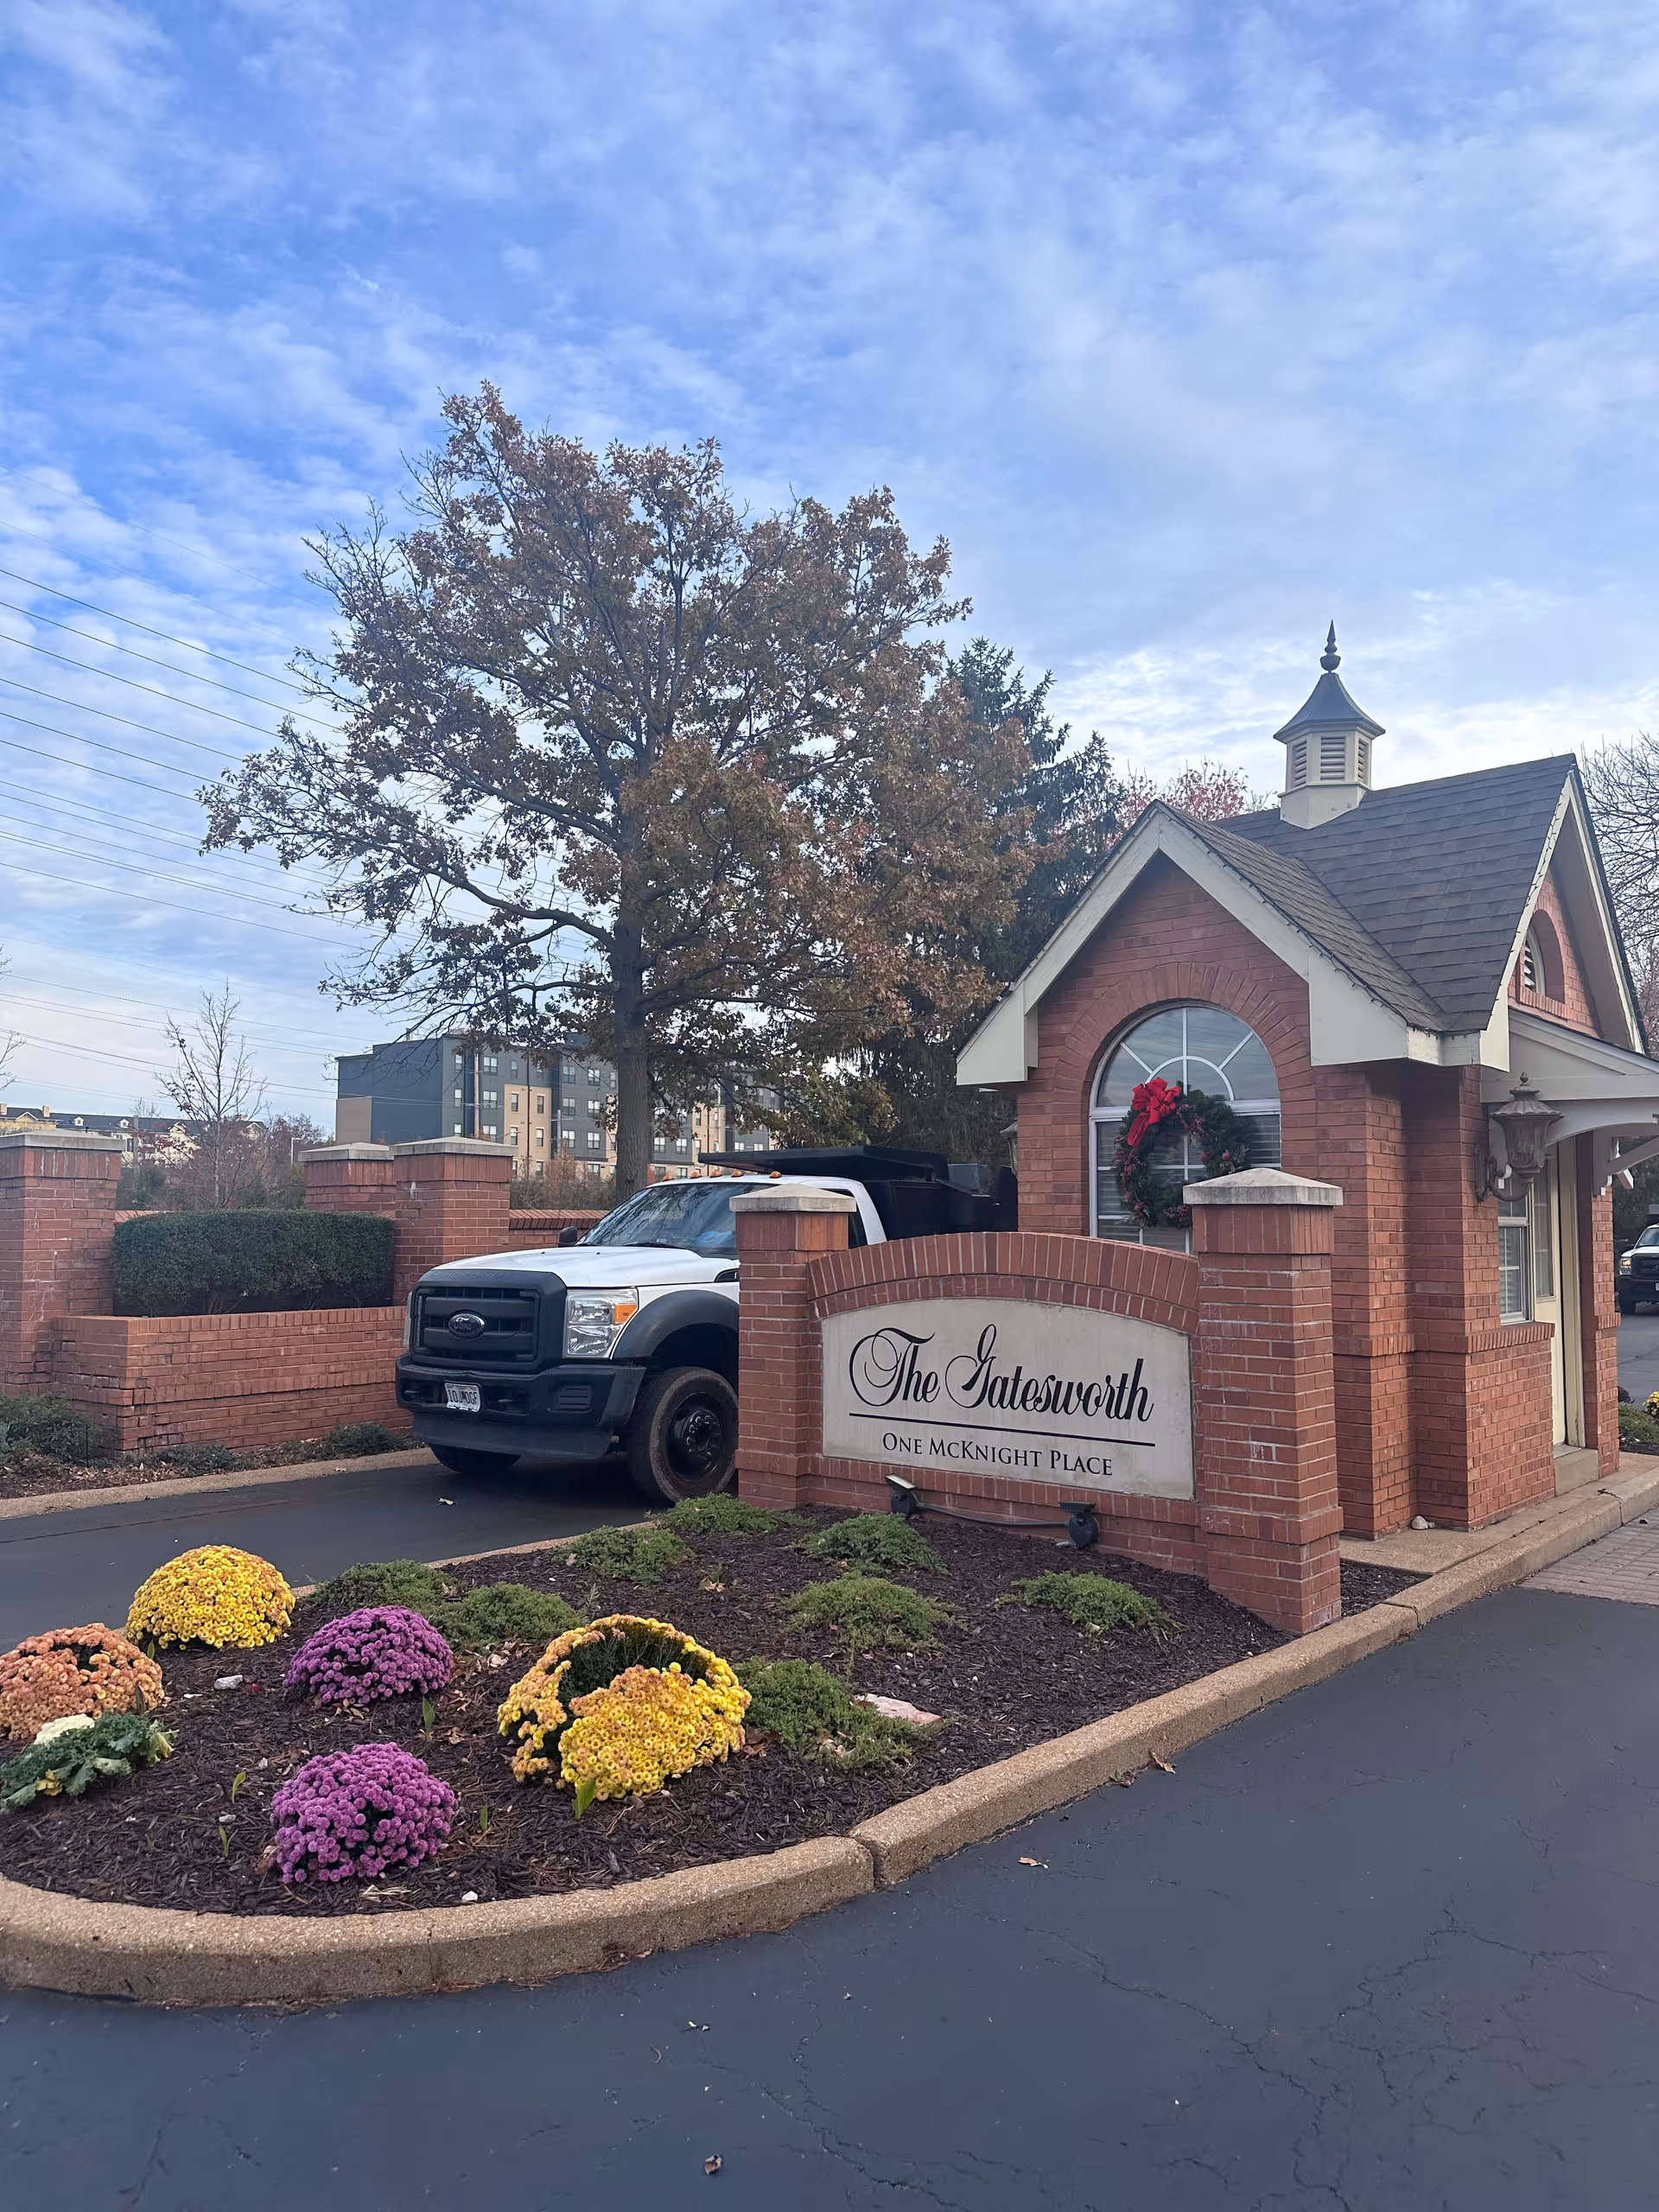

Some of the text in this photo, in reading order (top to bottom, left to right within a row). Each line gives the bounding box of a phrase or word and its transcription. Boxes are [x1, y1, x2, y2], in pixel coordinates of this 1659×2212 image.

[849, 1323, 1154, 1422] The Gatesworth
[882, 1432, 923, 1455] ONE
[1050, 1449, 1113, 1477] PLACE
